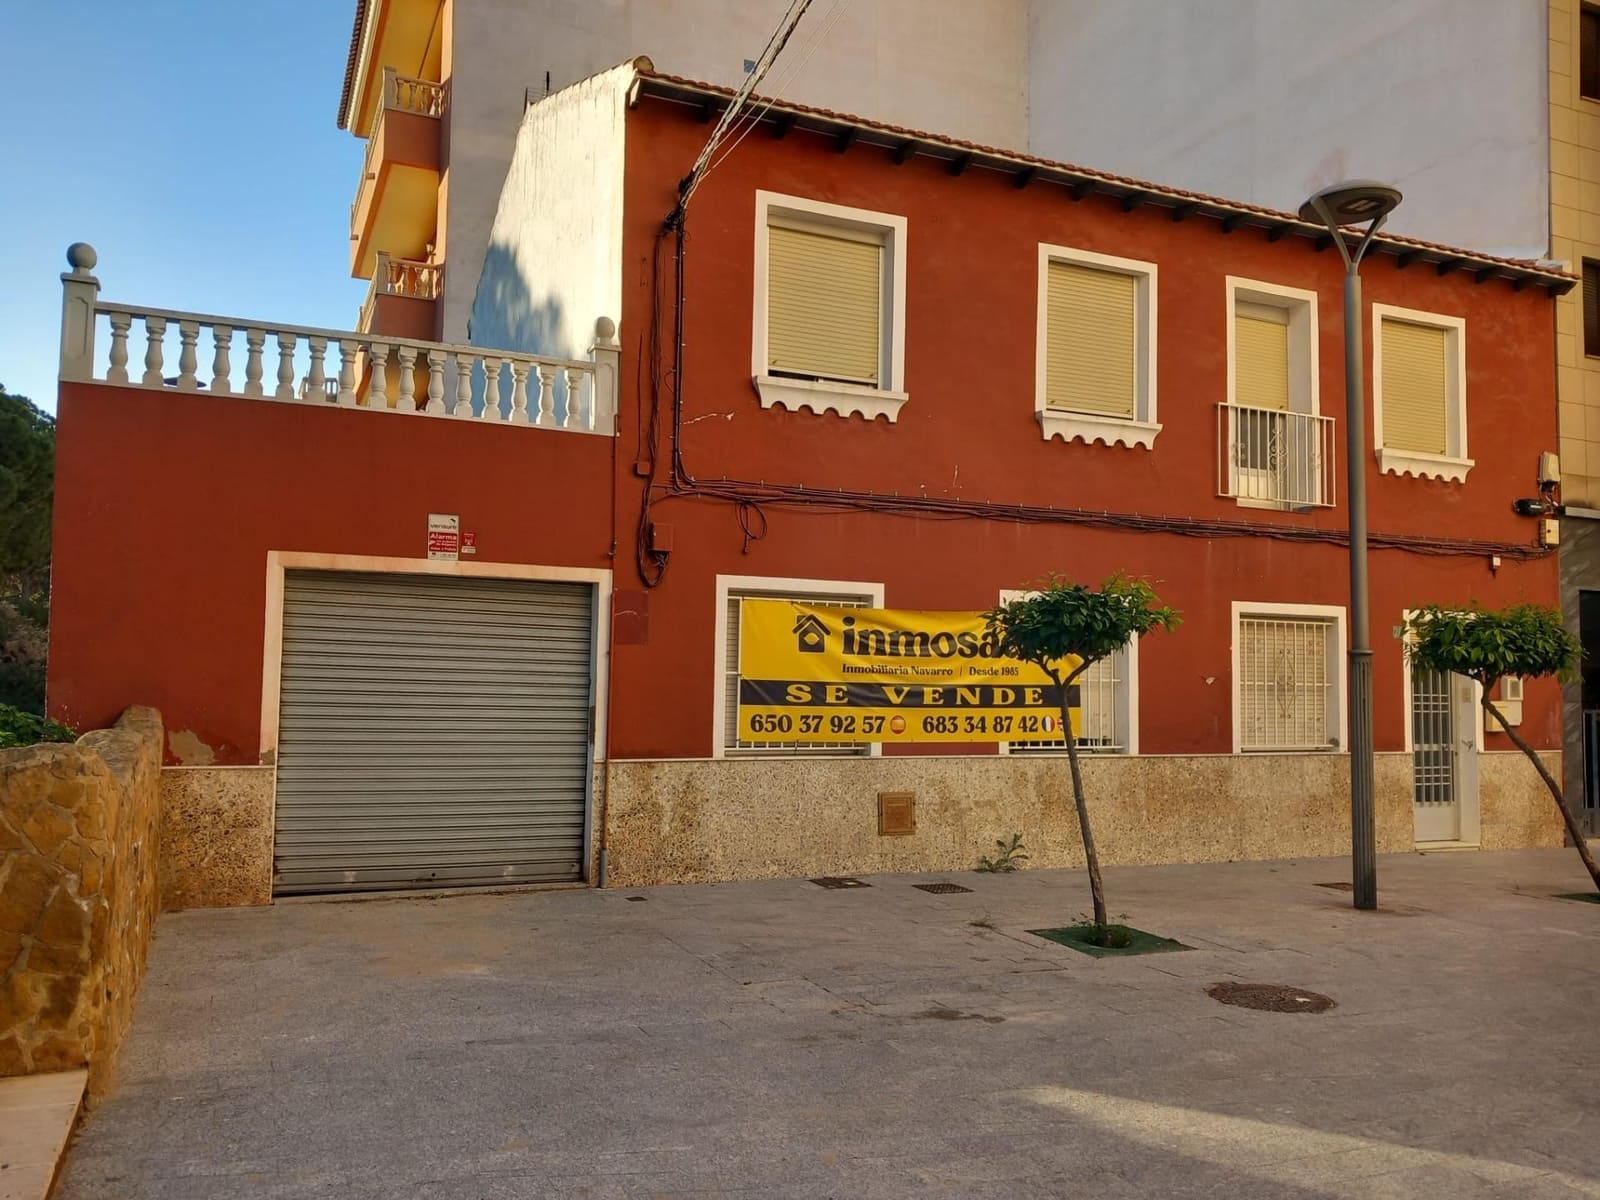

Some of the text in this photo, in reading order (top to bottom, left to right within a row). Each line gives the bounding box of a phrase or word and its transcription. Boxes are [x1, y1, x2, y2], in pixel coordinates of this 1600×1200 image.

[842, 663, 909, 676] Inmobiliaria
[911, 665, 953, 677] Navarro
[969, 666, 999, 677] Desde
[1001, 666, 1019, 677] 1985
[785, 684, 1043, 706] SE VENDE
[750, 713, 886, 735] 650 37 92 57
[922, 715, 1039, 734] 683 34 87 42
